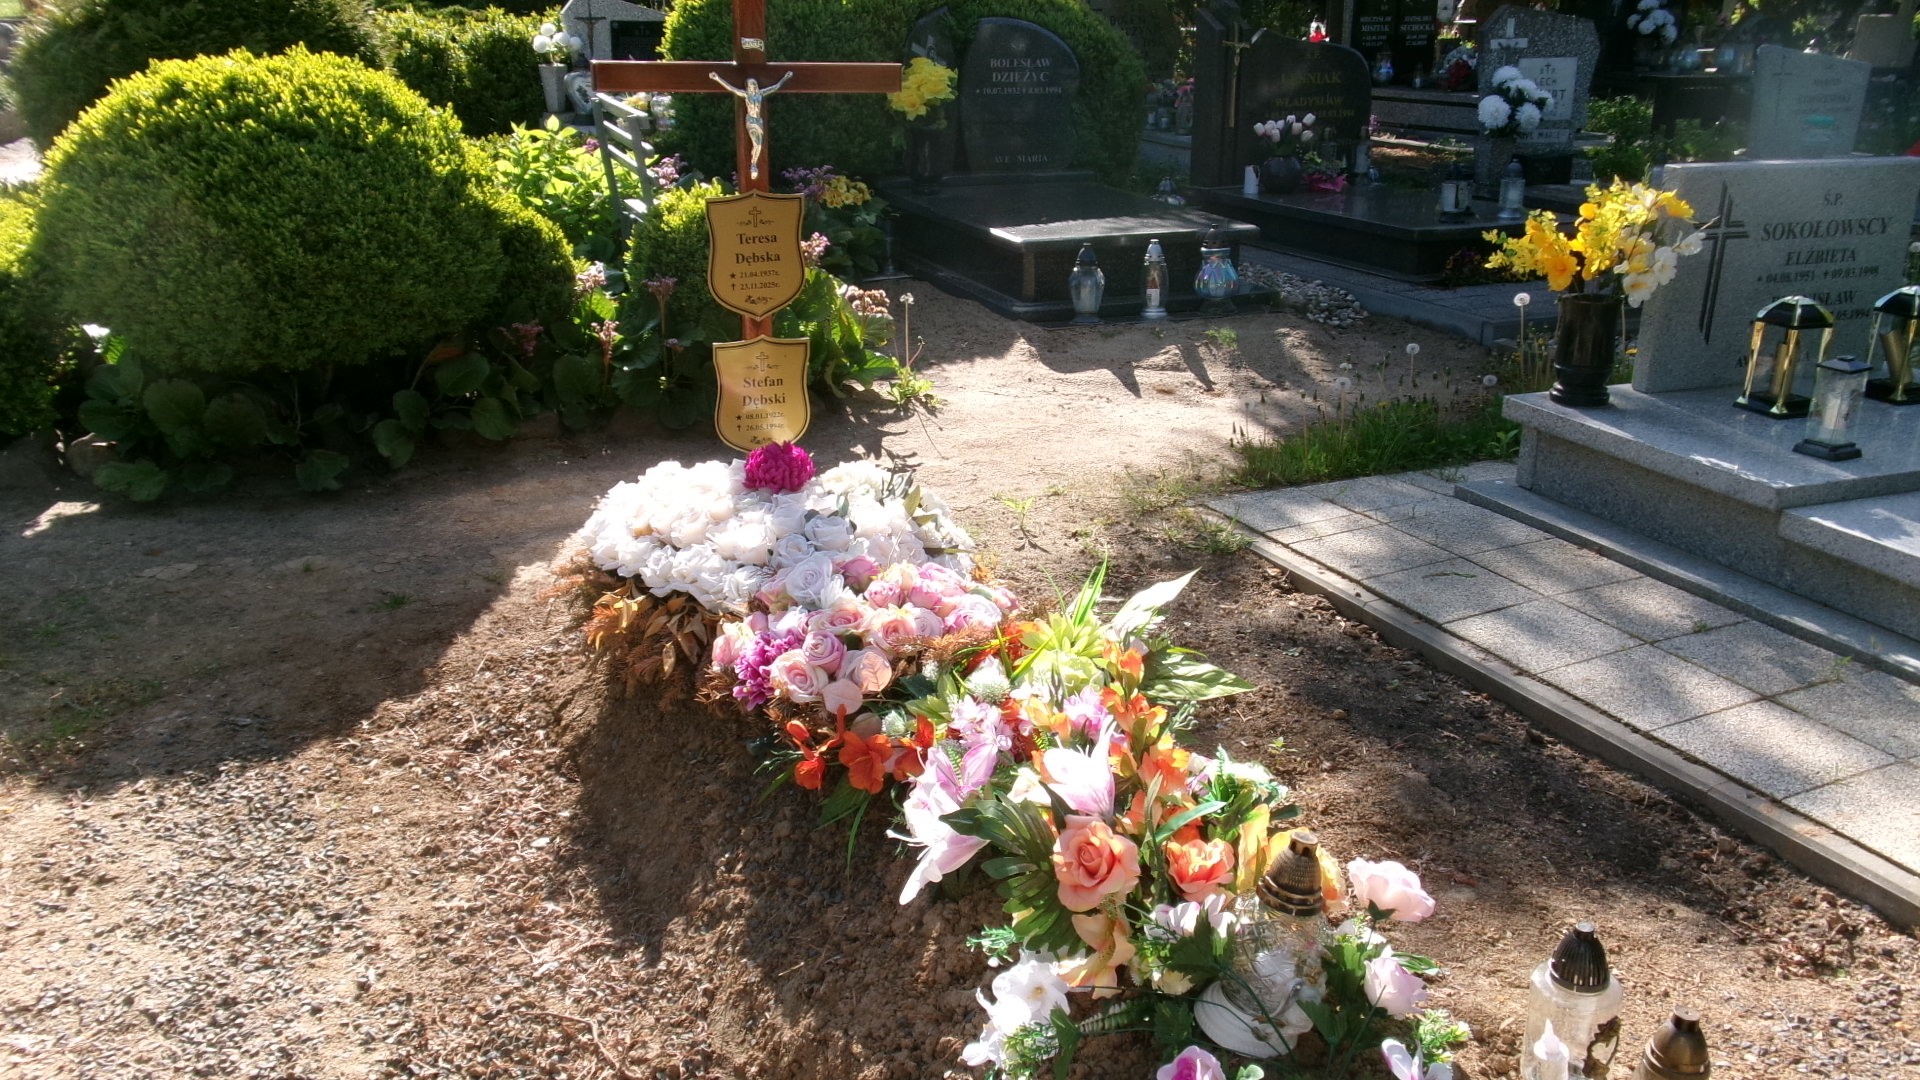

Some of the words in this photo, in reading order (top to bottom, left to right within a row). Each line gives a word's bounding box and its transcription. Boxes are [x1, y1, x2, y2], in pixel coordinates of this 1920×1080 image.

[990, 57, 1050, 68] BOLESŁAW
[992, 69, 1049, 82] DZIEŻYC
[1017, 154, 1049, 163] MARIA
[1760, 216, 1893, 242] SOKOŁOWSCY
[735, 232, 778, 245] Teresa
[735, 251, 781, 267] Dębska
[1784, 247, 1857, 266] ELŻBIETA
[743, 375, 784, 388] Stefan
[742, 392, 786, 408] Dębski
